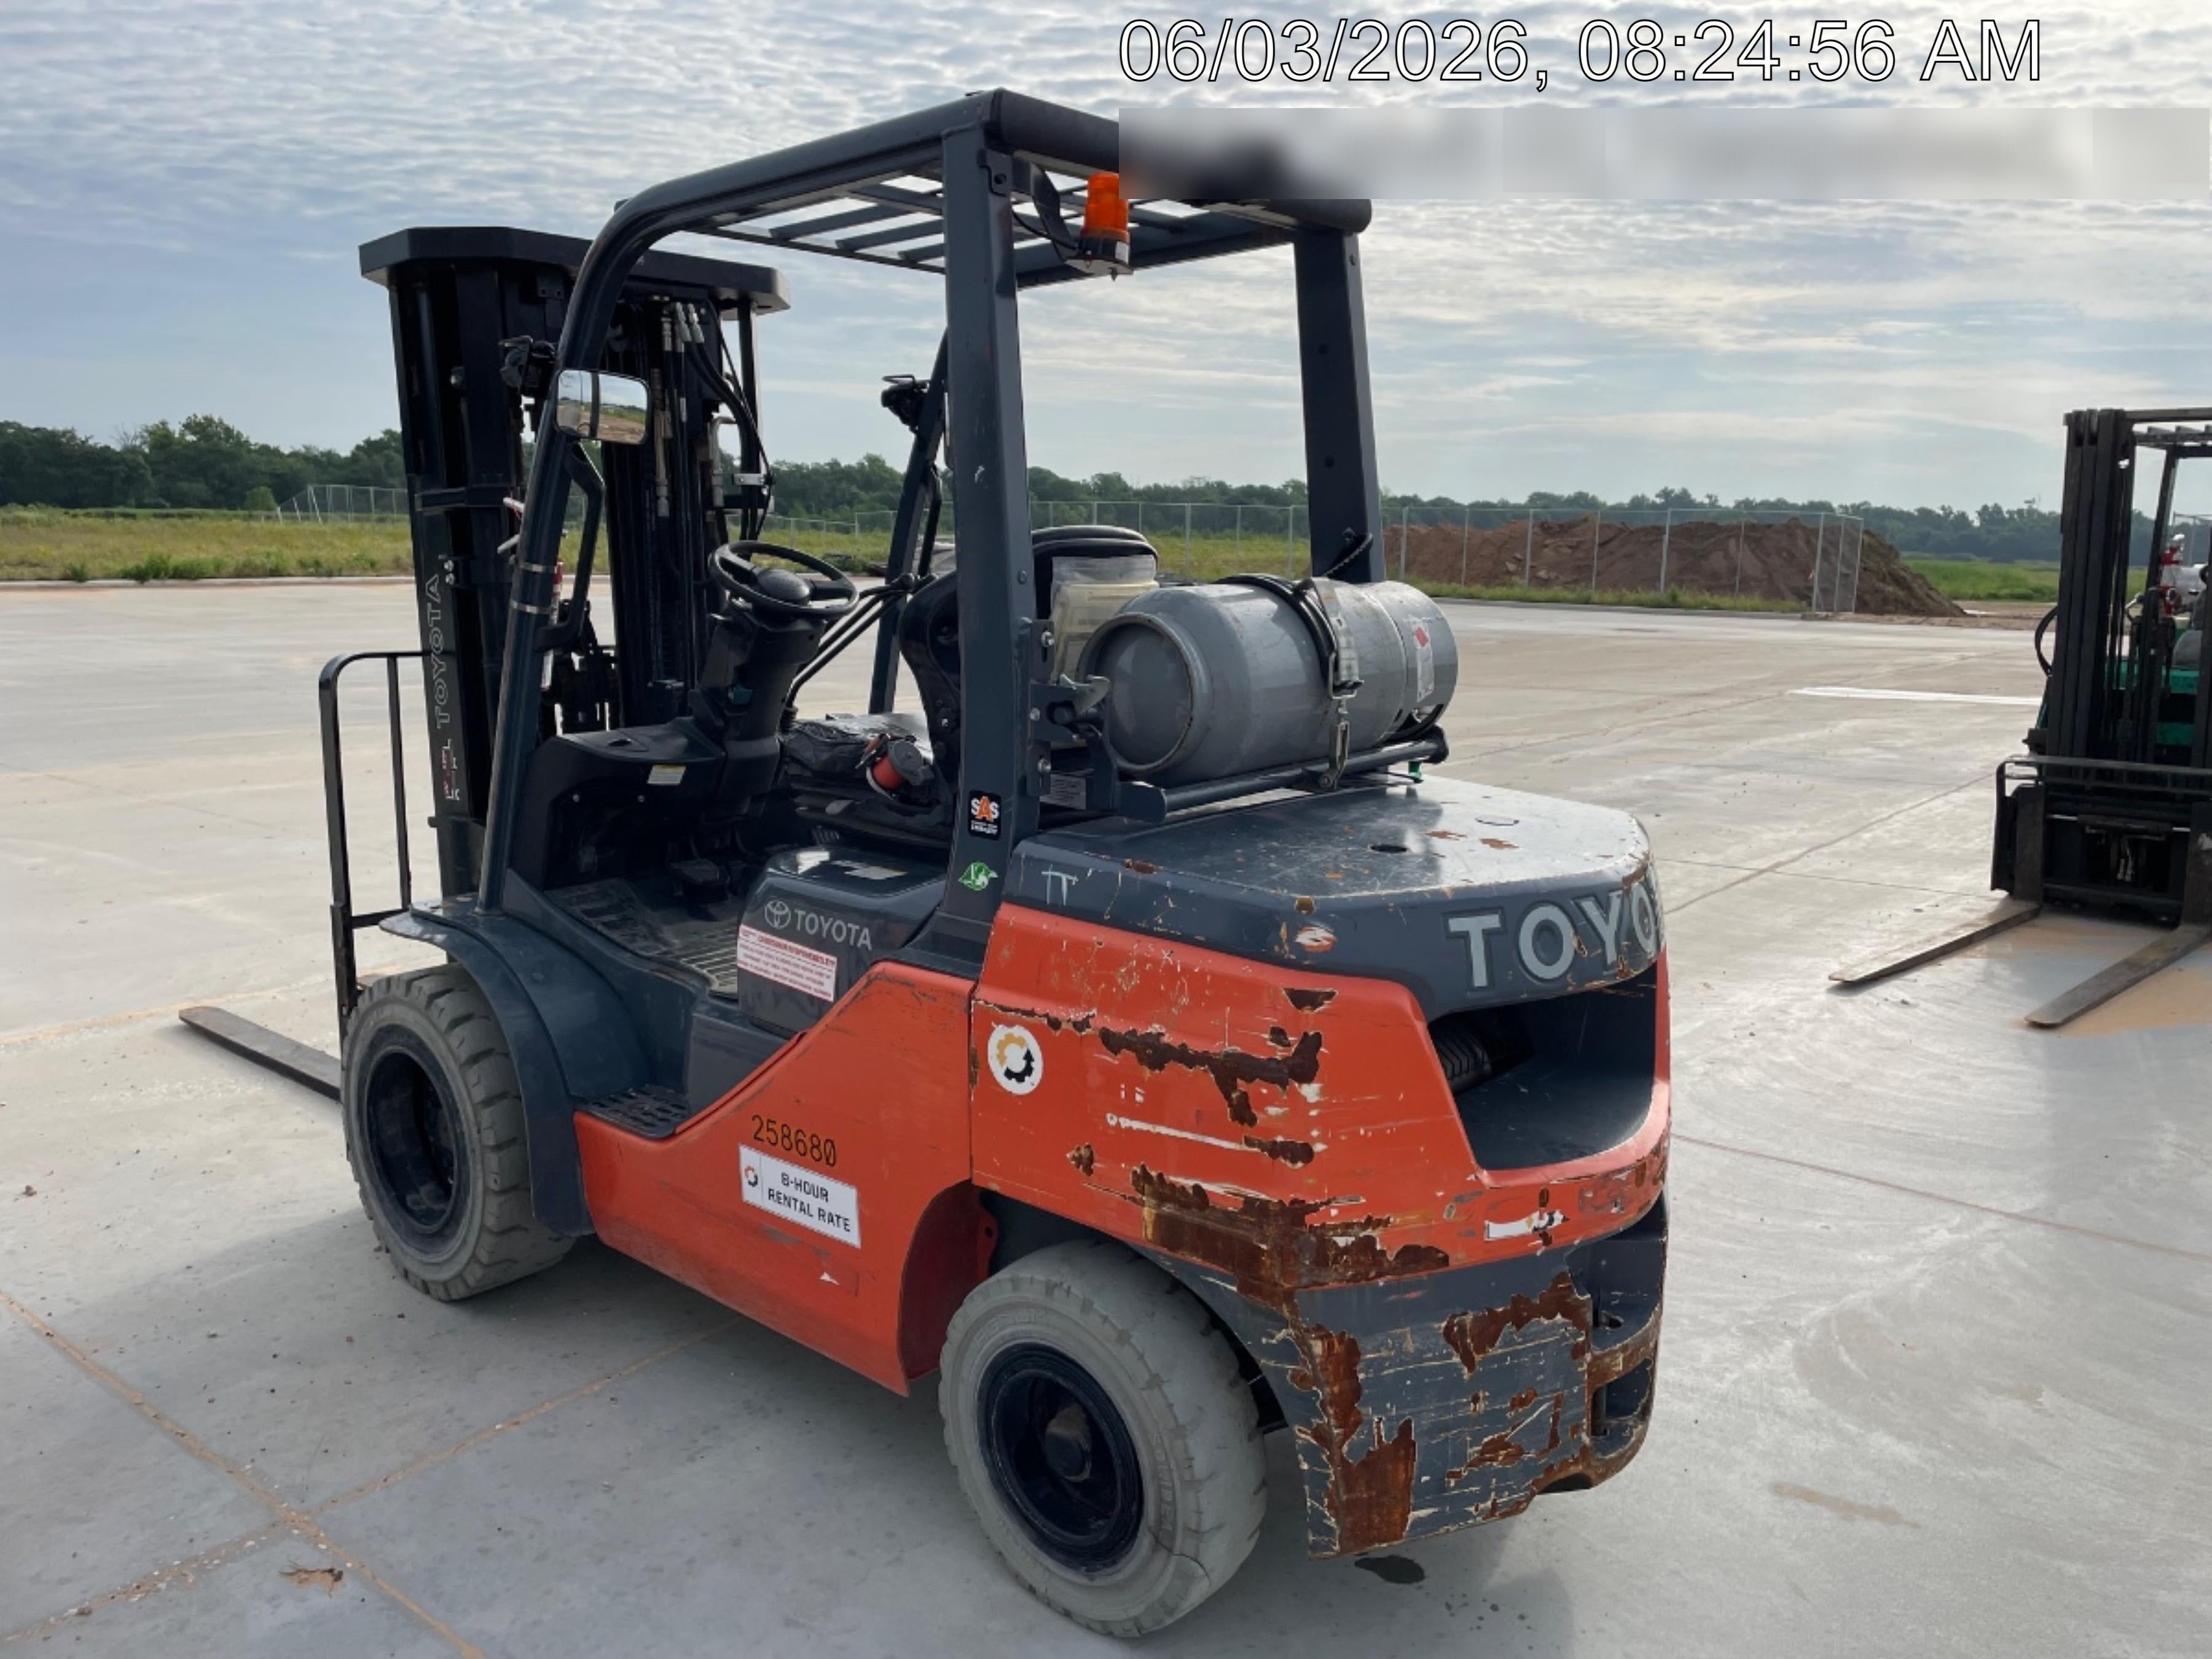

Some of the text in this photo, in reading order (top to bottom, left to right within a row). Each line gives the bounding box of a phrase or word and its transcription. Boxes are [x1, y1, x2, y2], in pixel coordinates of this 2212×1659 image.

[426, 574, 450, 729] TOYOTA
[971, 796, 1000, 823] SAS
[794, 909, 872, 951] TOYOTA
[1448, 876, 1657, 987] TOYO
[751, 1115, 836, 1167] 258680
[769, 1188, 850, 1232] RENTAL RATE
